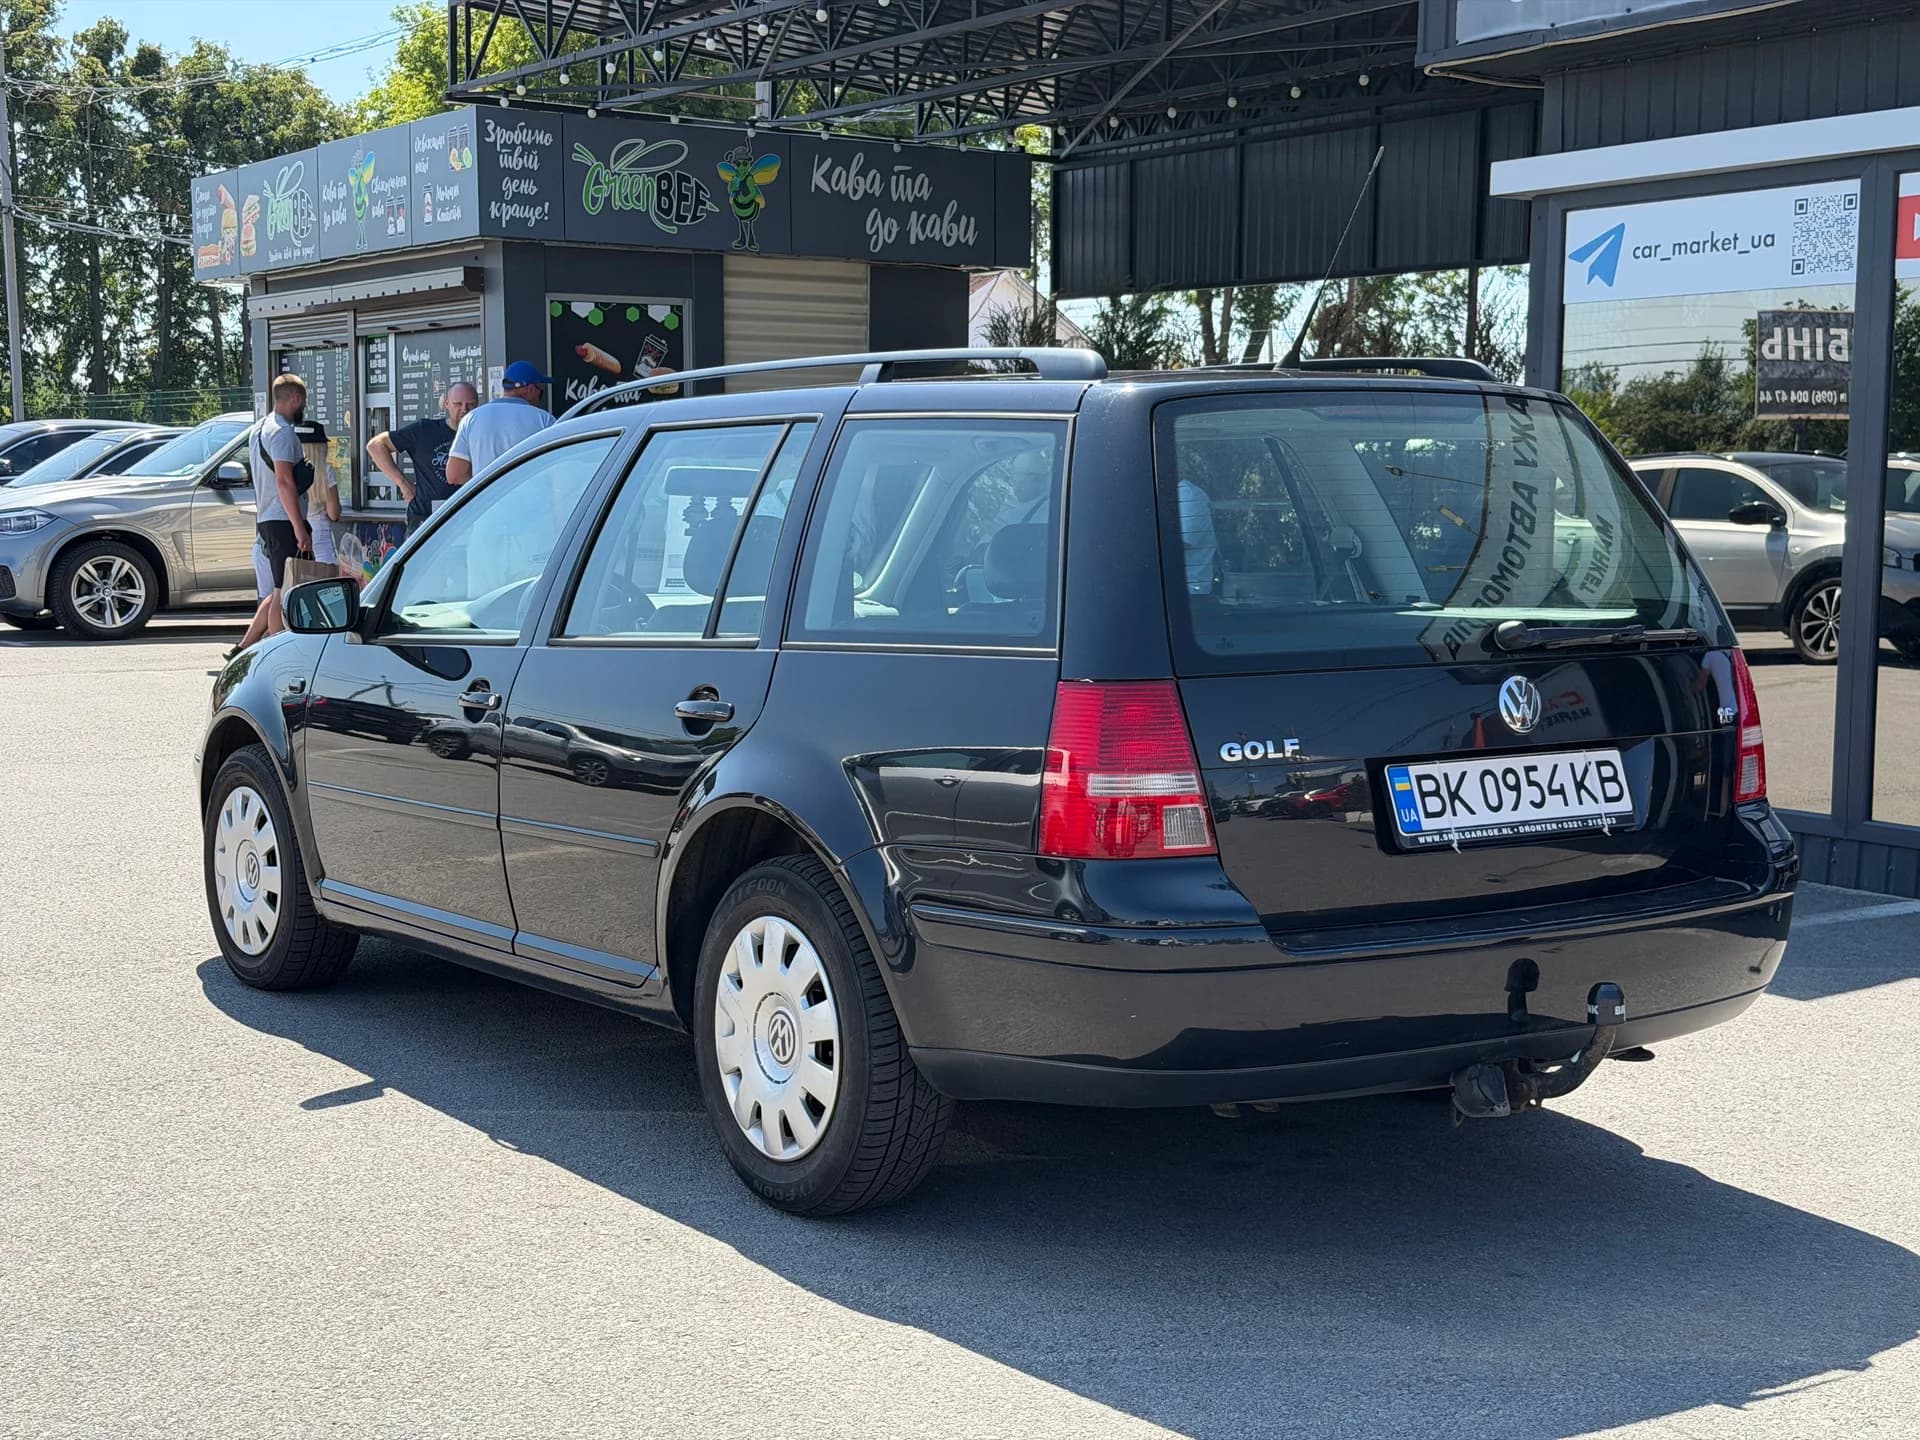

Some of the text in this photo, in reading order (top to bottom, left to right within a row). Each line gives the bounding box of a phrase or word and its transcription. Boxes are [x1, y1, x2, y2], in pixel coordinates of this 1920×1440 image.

[484, 119, 553, 151] Зробимо
[499, 146, 540, 171] твій
[502, 175, 538, 200] день
[811, 152, 933, 203] Кава та
[489, 201, 550, 228] краще!
[865, 199, 979, 253] до кави
[1632, 231, 1776, 262] car_market_ua
[1219, 738, 1300, 762] GOLF
[1415, 760, 1625, 819] BK 0954 KB
[1400, 808, 1419, 823] UA
